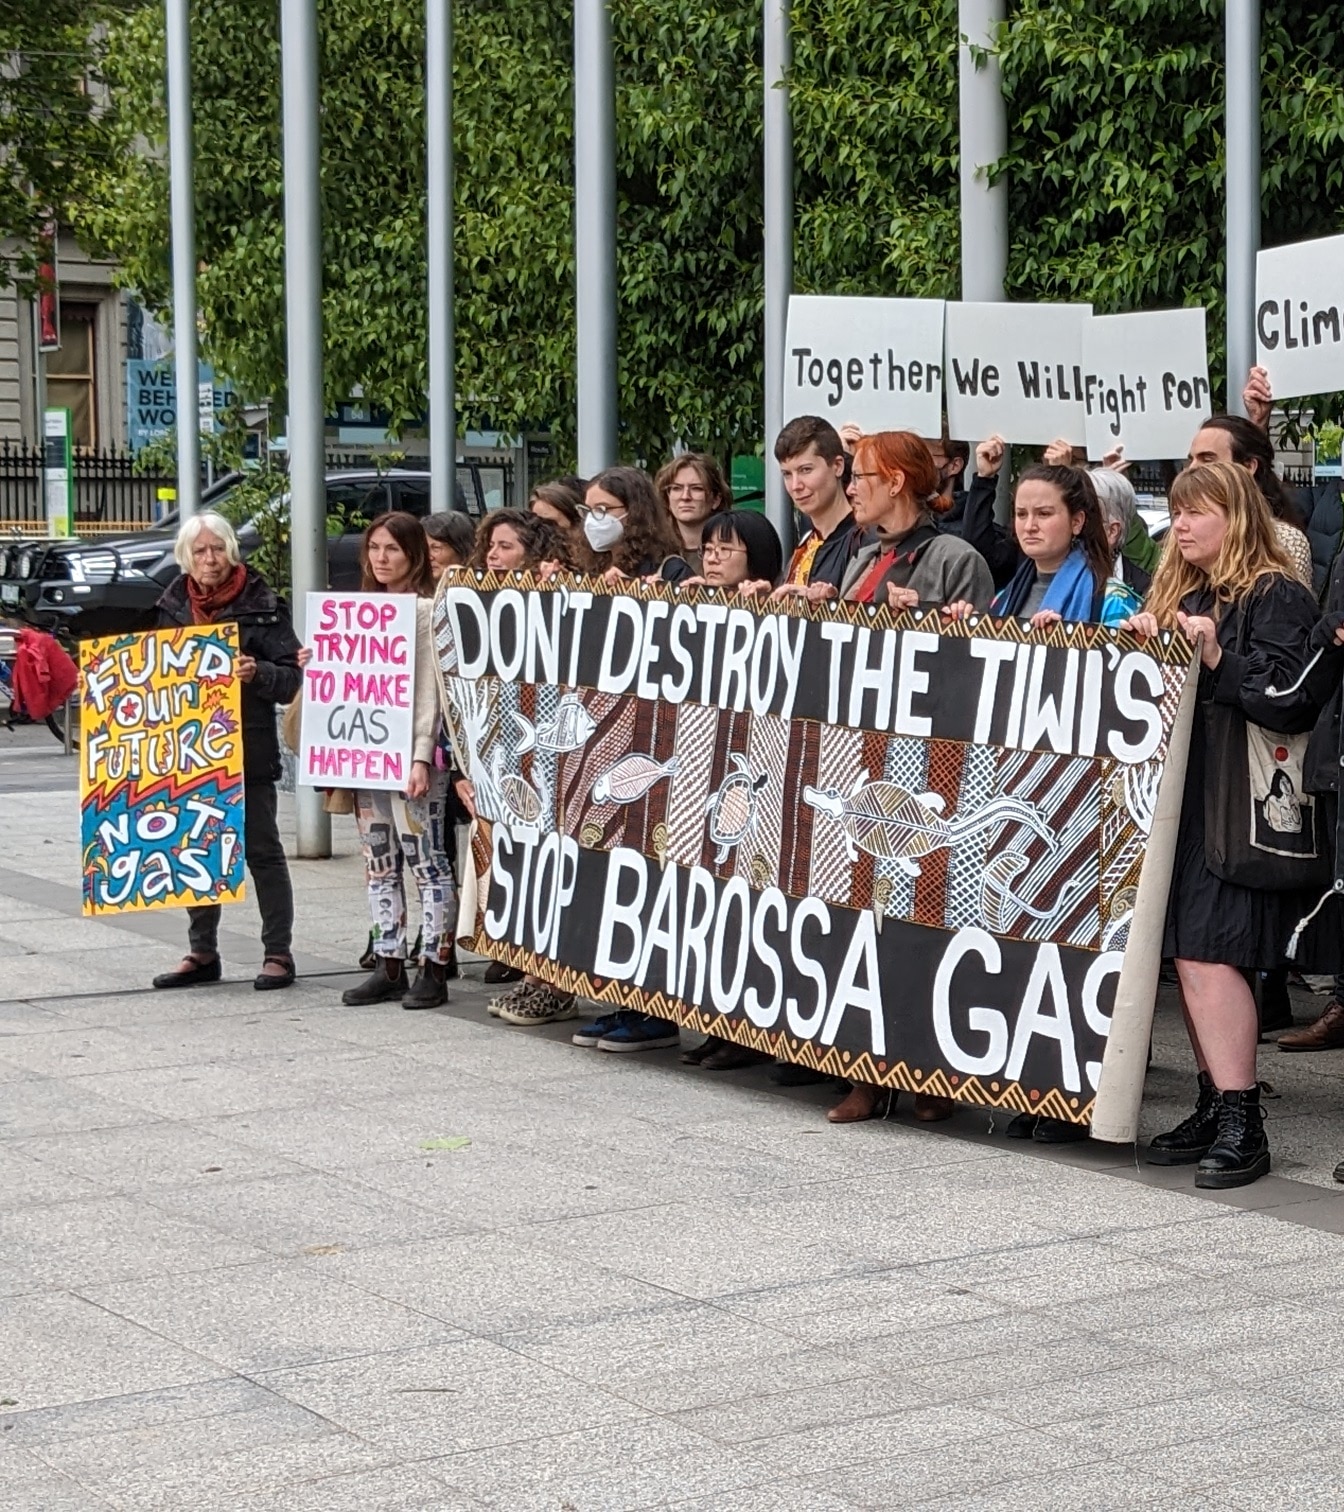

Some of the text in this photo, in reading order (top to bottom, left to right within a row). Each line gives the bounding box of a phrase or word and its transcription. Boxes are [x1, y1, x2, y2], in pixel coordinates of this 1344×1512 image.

[792, 348, 941, 406] Together
[952, 358, 999, 397] We
[319, 599, 397, 632] STOP
[313, 633, 408, 666] TRYING
[85, 633, 232, 714] FUND
[306, 669, 410, 708] TO MAKE
[446, 585, 1165, 764] DON'T DESTROY THE TIWI'S
[327, 705, 389, 745] GAS
[308, 745, 403, 780] HAPPEN
[99, 799, 225, 853] NOT
[484, 821, 579, 961] STOP
[593, 847, 886, 1056] BAROSSA
